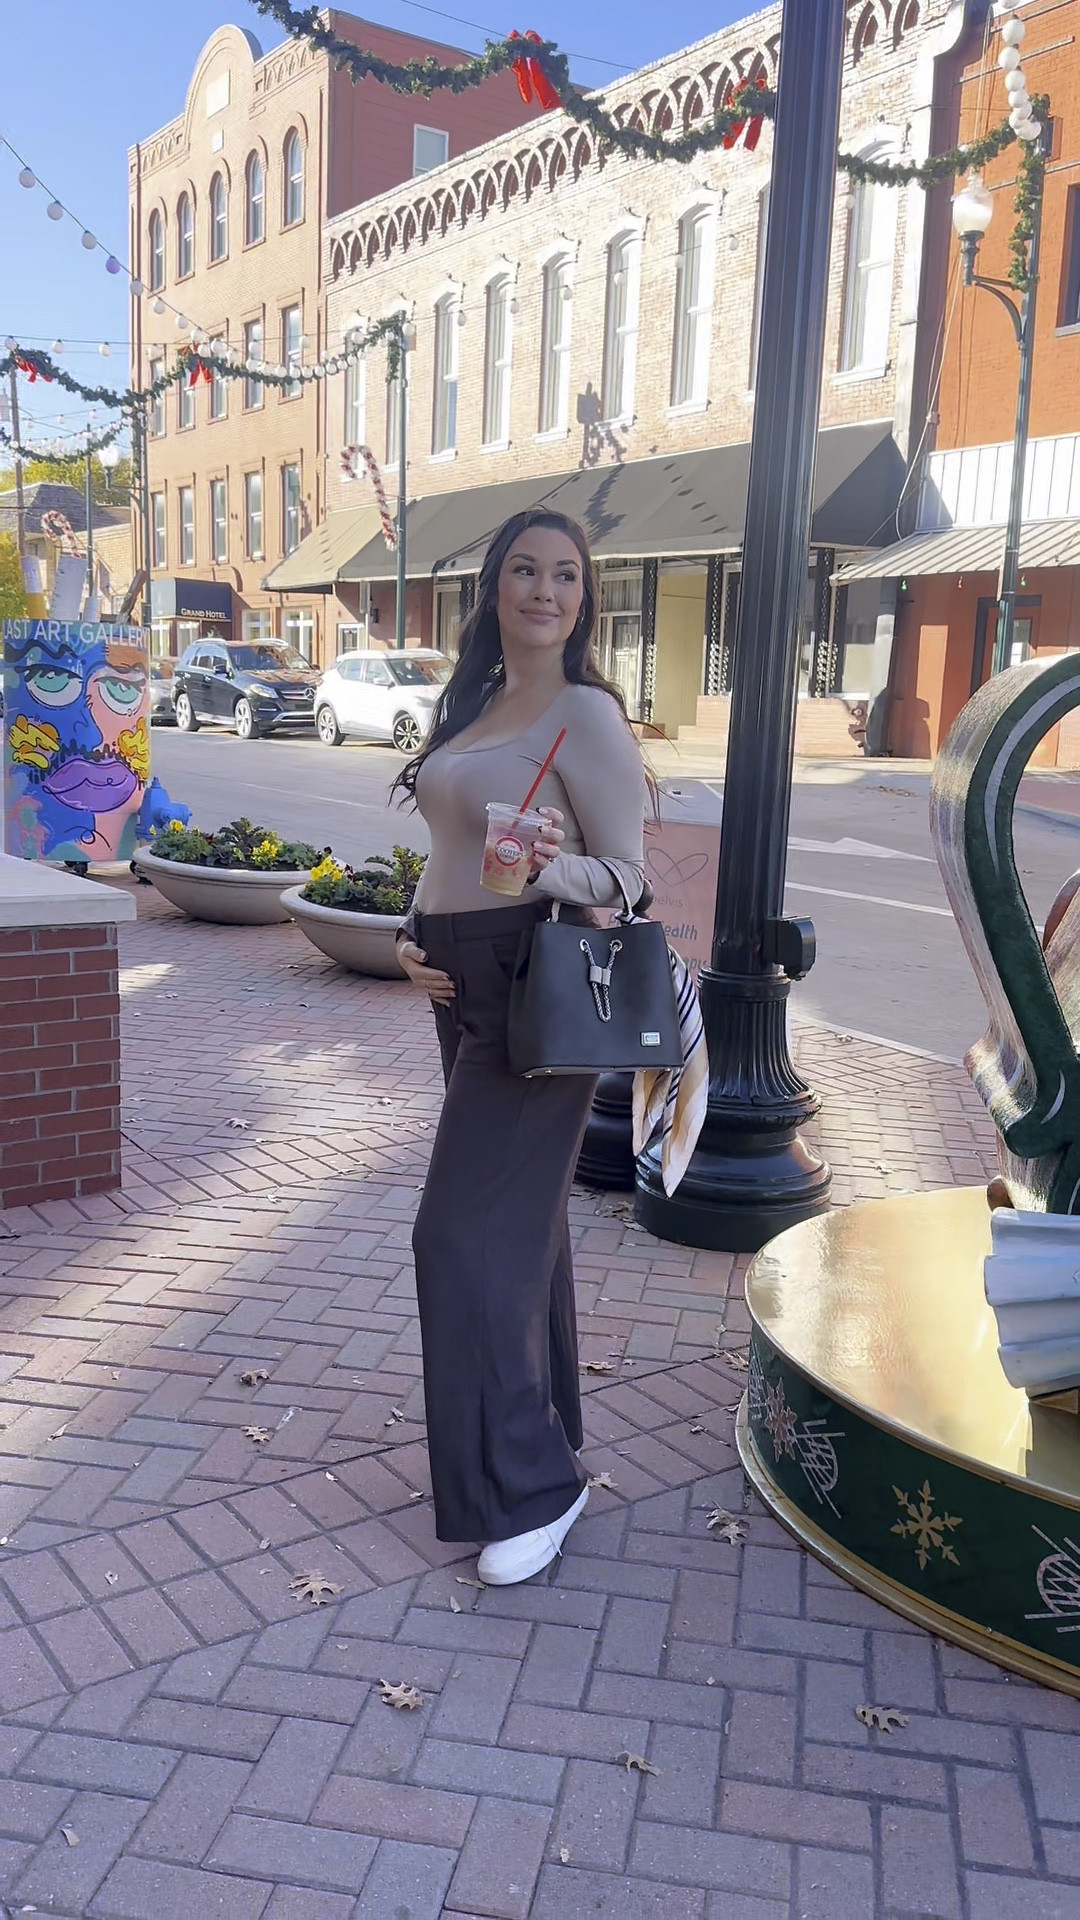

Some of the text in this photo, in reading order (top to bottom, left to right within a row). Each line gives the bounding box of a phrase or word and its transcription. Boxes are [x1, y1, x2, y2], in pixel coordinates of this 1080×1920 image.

[180, 608, 227, 619] GRAND HOTEL
[34, 620, 73, 642] ART
[662, 922, 699, 941] ealth
